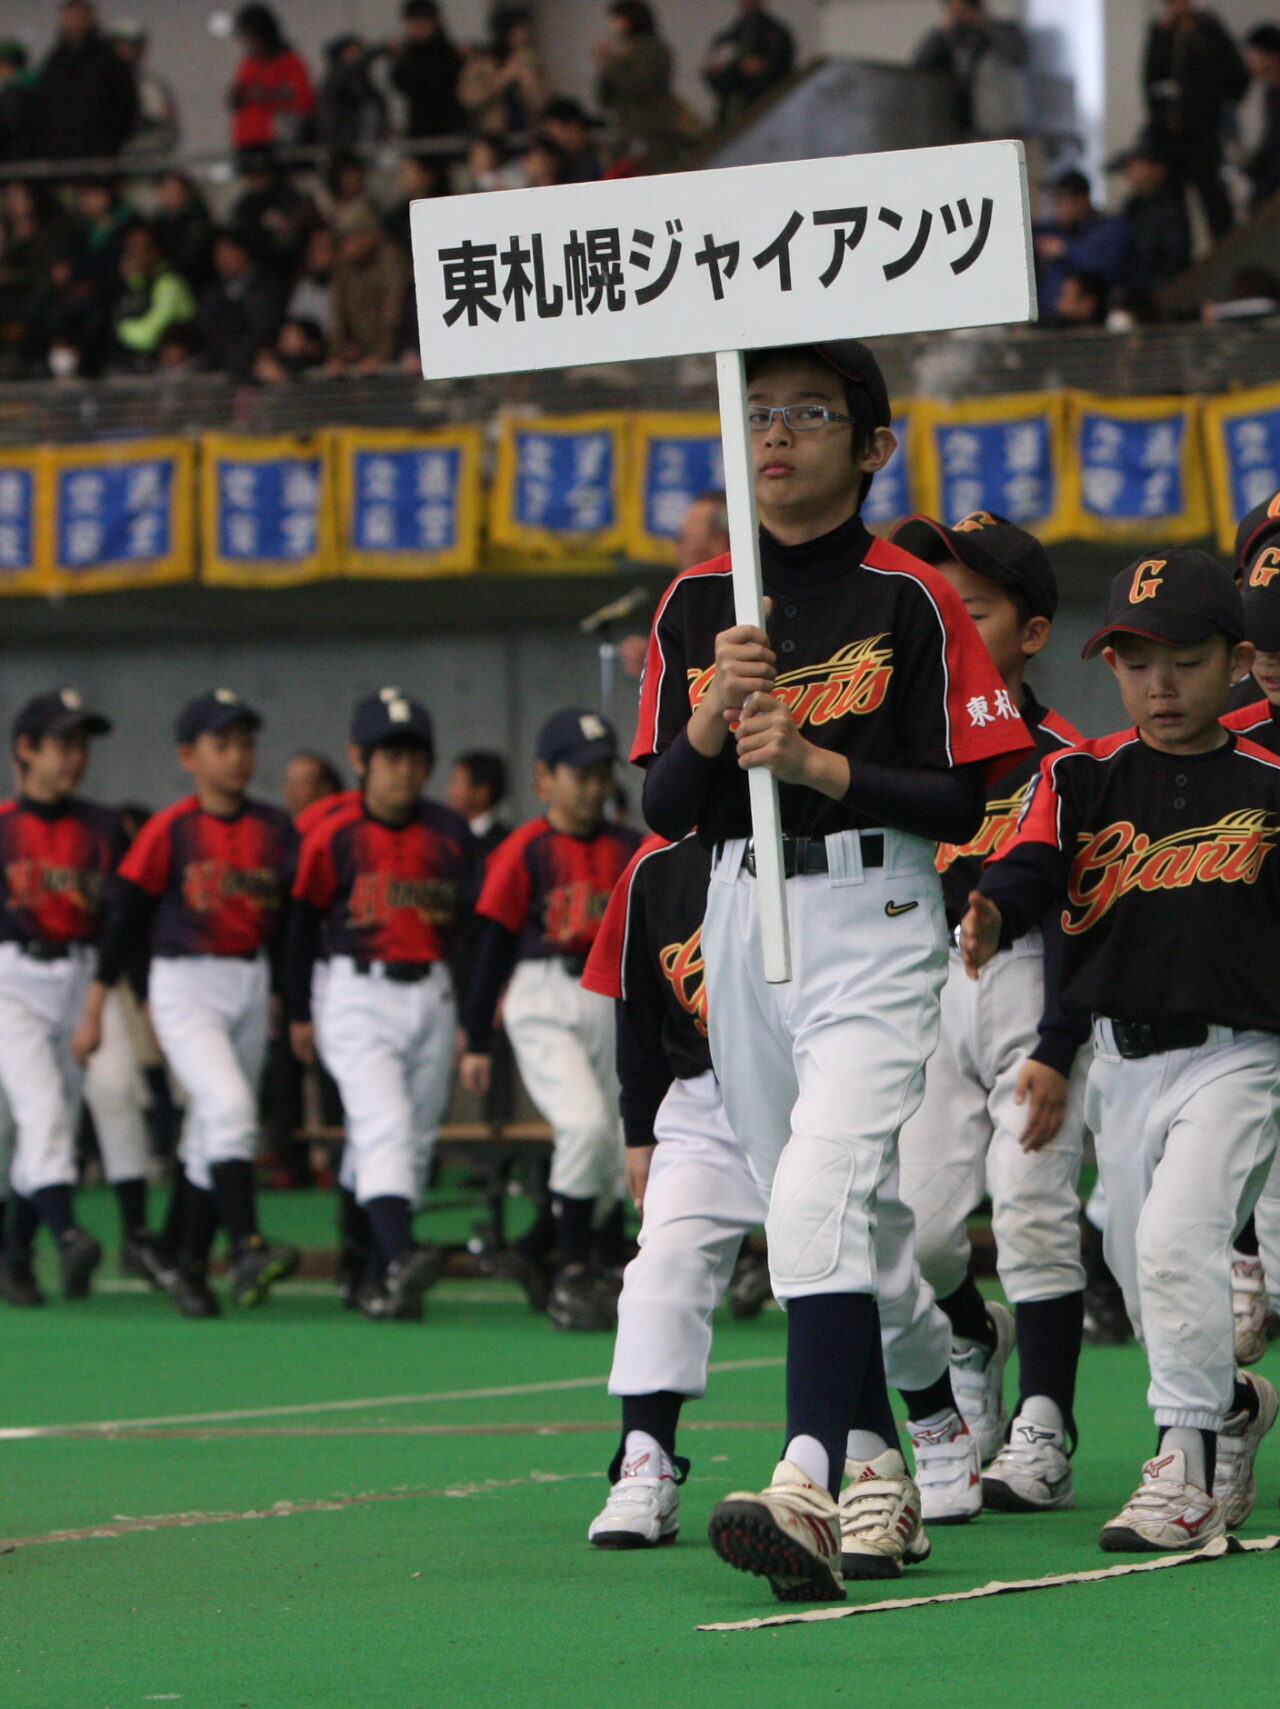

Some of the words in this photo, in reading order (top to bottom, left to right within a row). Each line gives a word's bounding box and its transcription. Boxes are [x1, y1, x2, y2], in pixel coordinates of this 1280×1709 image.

[438, 196, 994, 328] 東札幌ジャイアンツ
[1129, 559, 1168, 604] G
